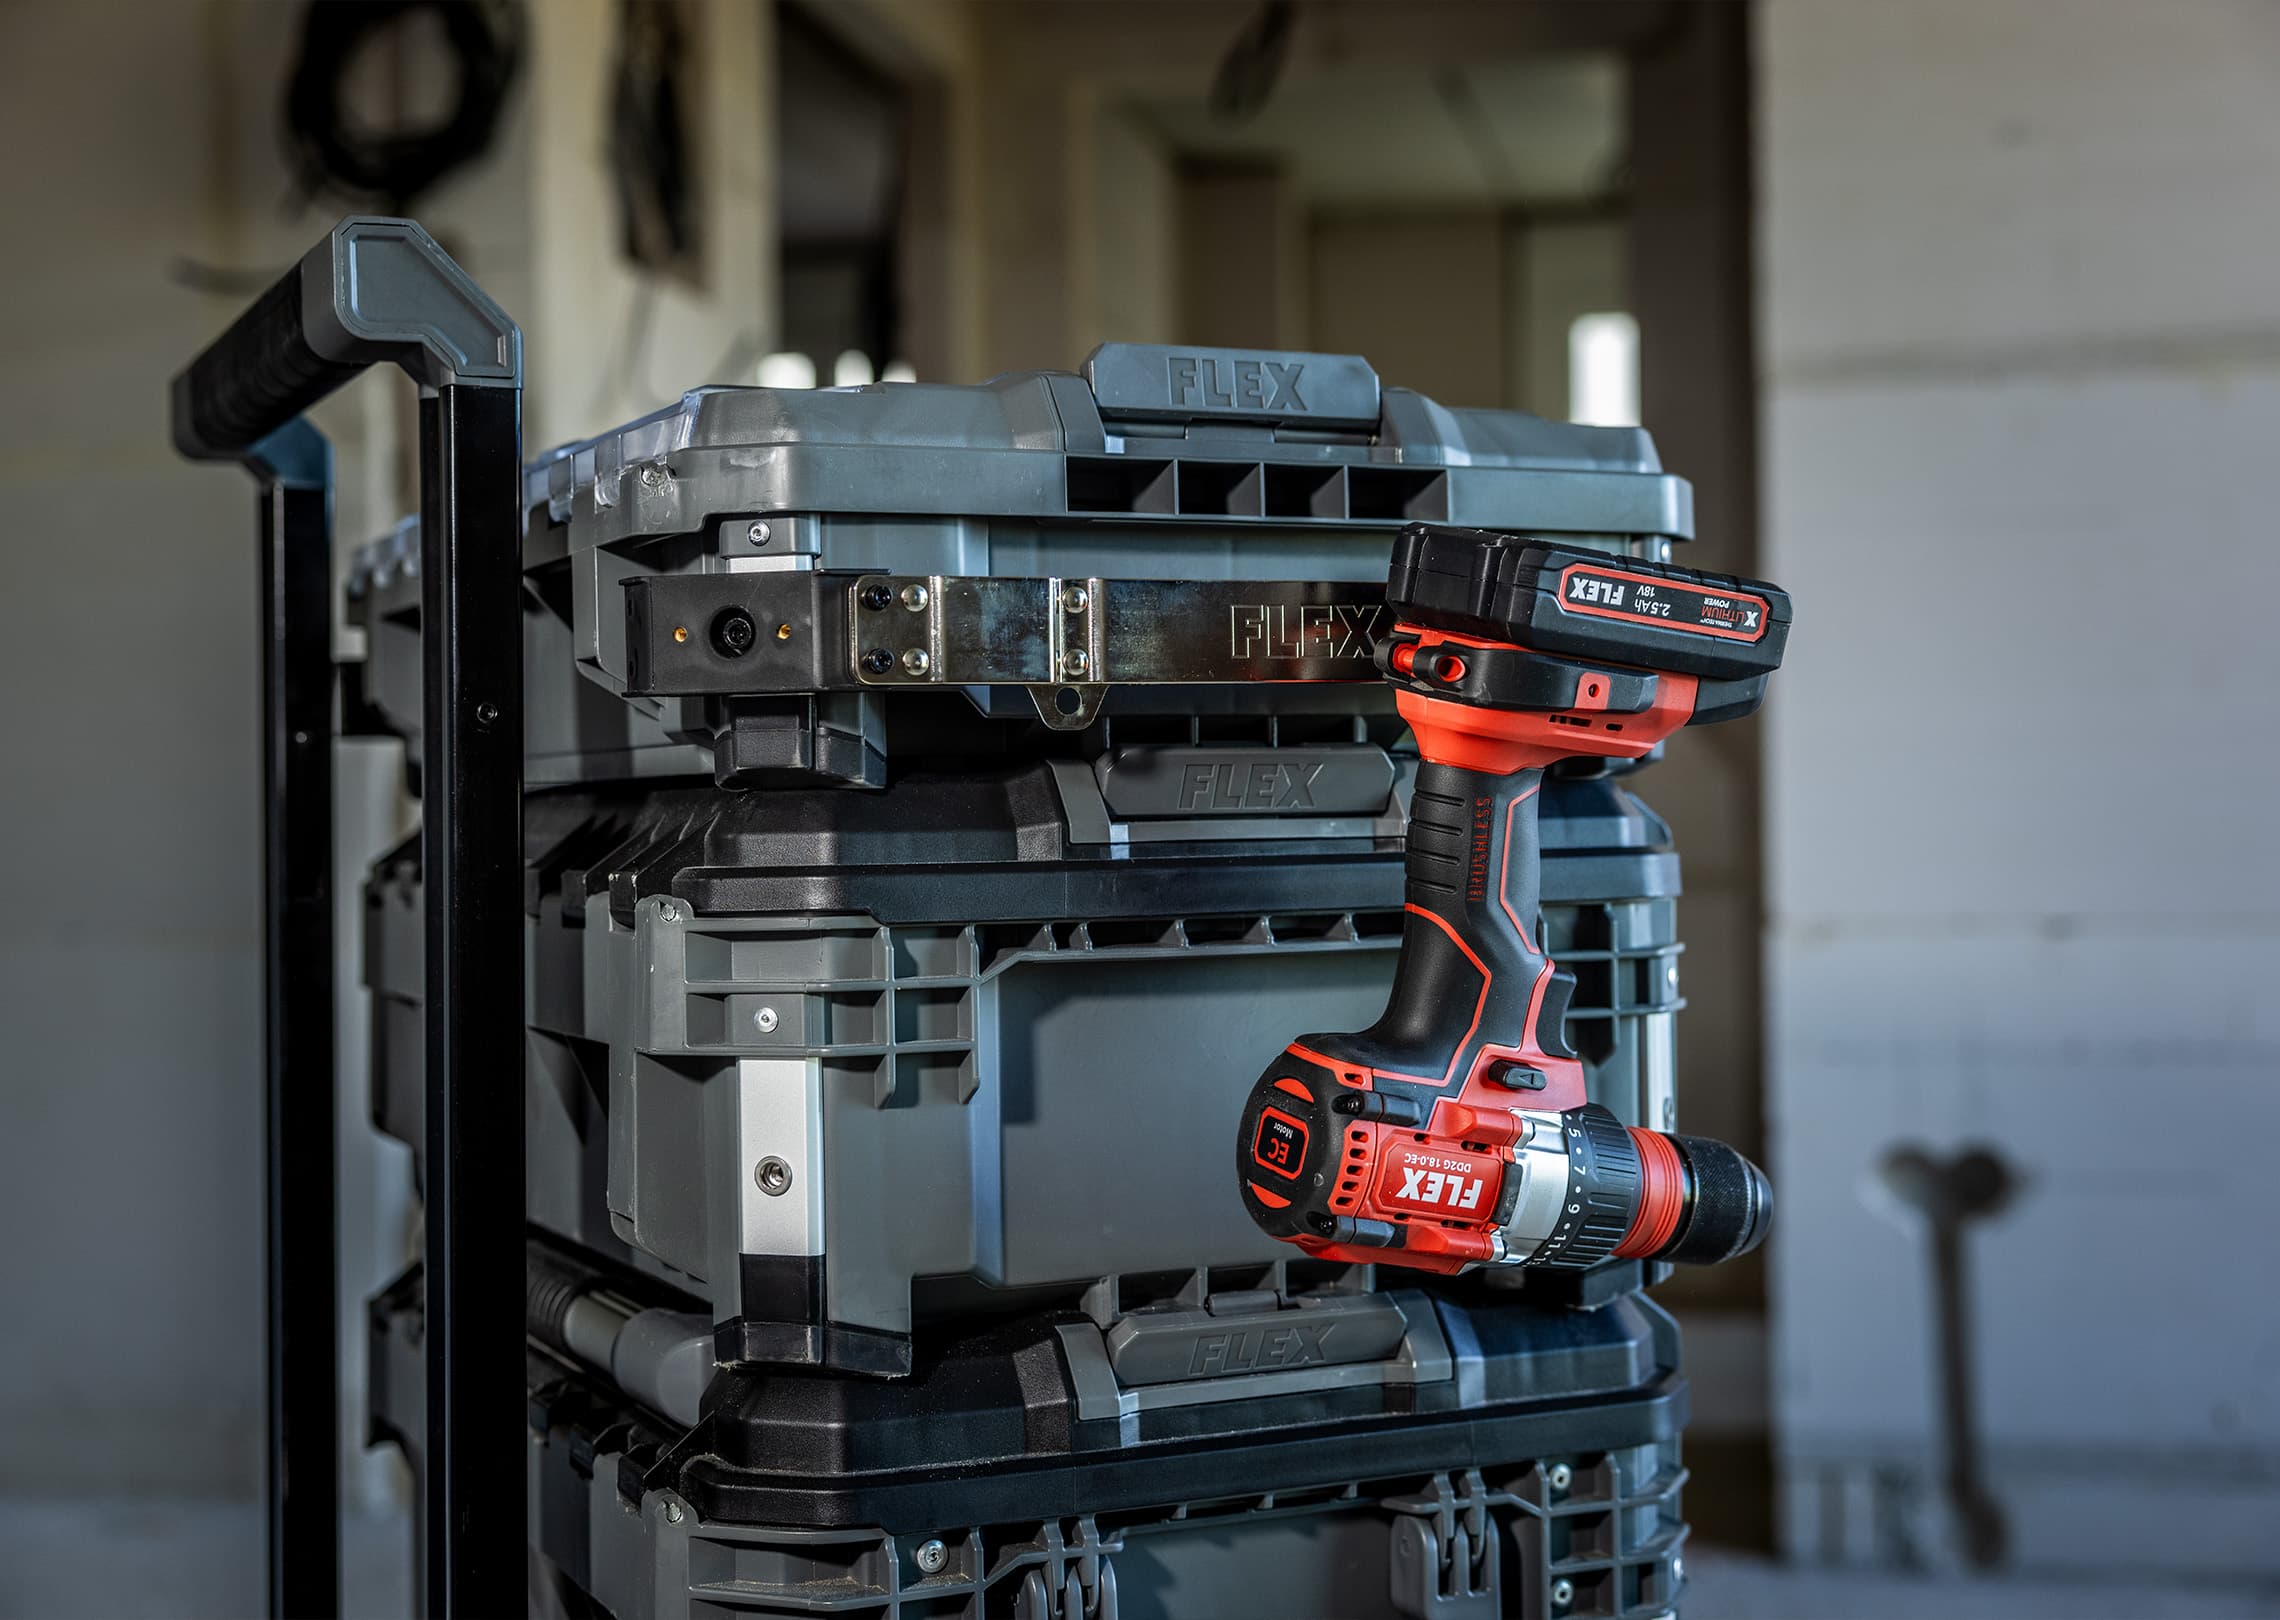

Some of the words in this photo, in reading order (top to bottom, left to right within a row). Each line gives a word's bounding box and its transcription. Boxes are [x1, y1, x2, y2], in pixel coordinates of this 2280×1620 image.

[1167, 357, 1308, 411] FLEX
[1570, 577, 1625, 606] FLEX
[1636, 584, 1656, 598] 18V
[1703, 597, 1730, 609] POWER
[1634, 598, 1671, 617] 2.5Ah
[1700, 605, 1745, 624] LITHIUM
[1231, 604, 1382, 659] FLEX
[1177, 763, 1324, 811] FLEX
[1467, 796, 1492, 902] BRUSHLESS
[1273, 1121, 1294, 1140] Motor
[1268, 1137, 1290, 1165] EC
[1404, 1152, 1441, 1168] 18.0-EC
[1443, 1156, 1472, 1173] DD2G
[1395, 1166, 1484, 1210] FLEX
[1188, 1323, 1337, 1377] FLEX
